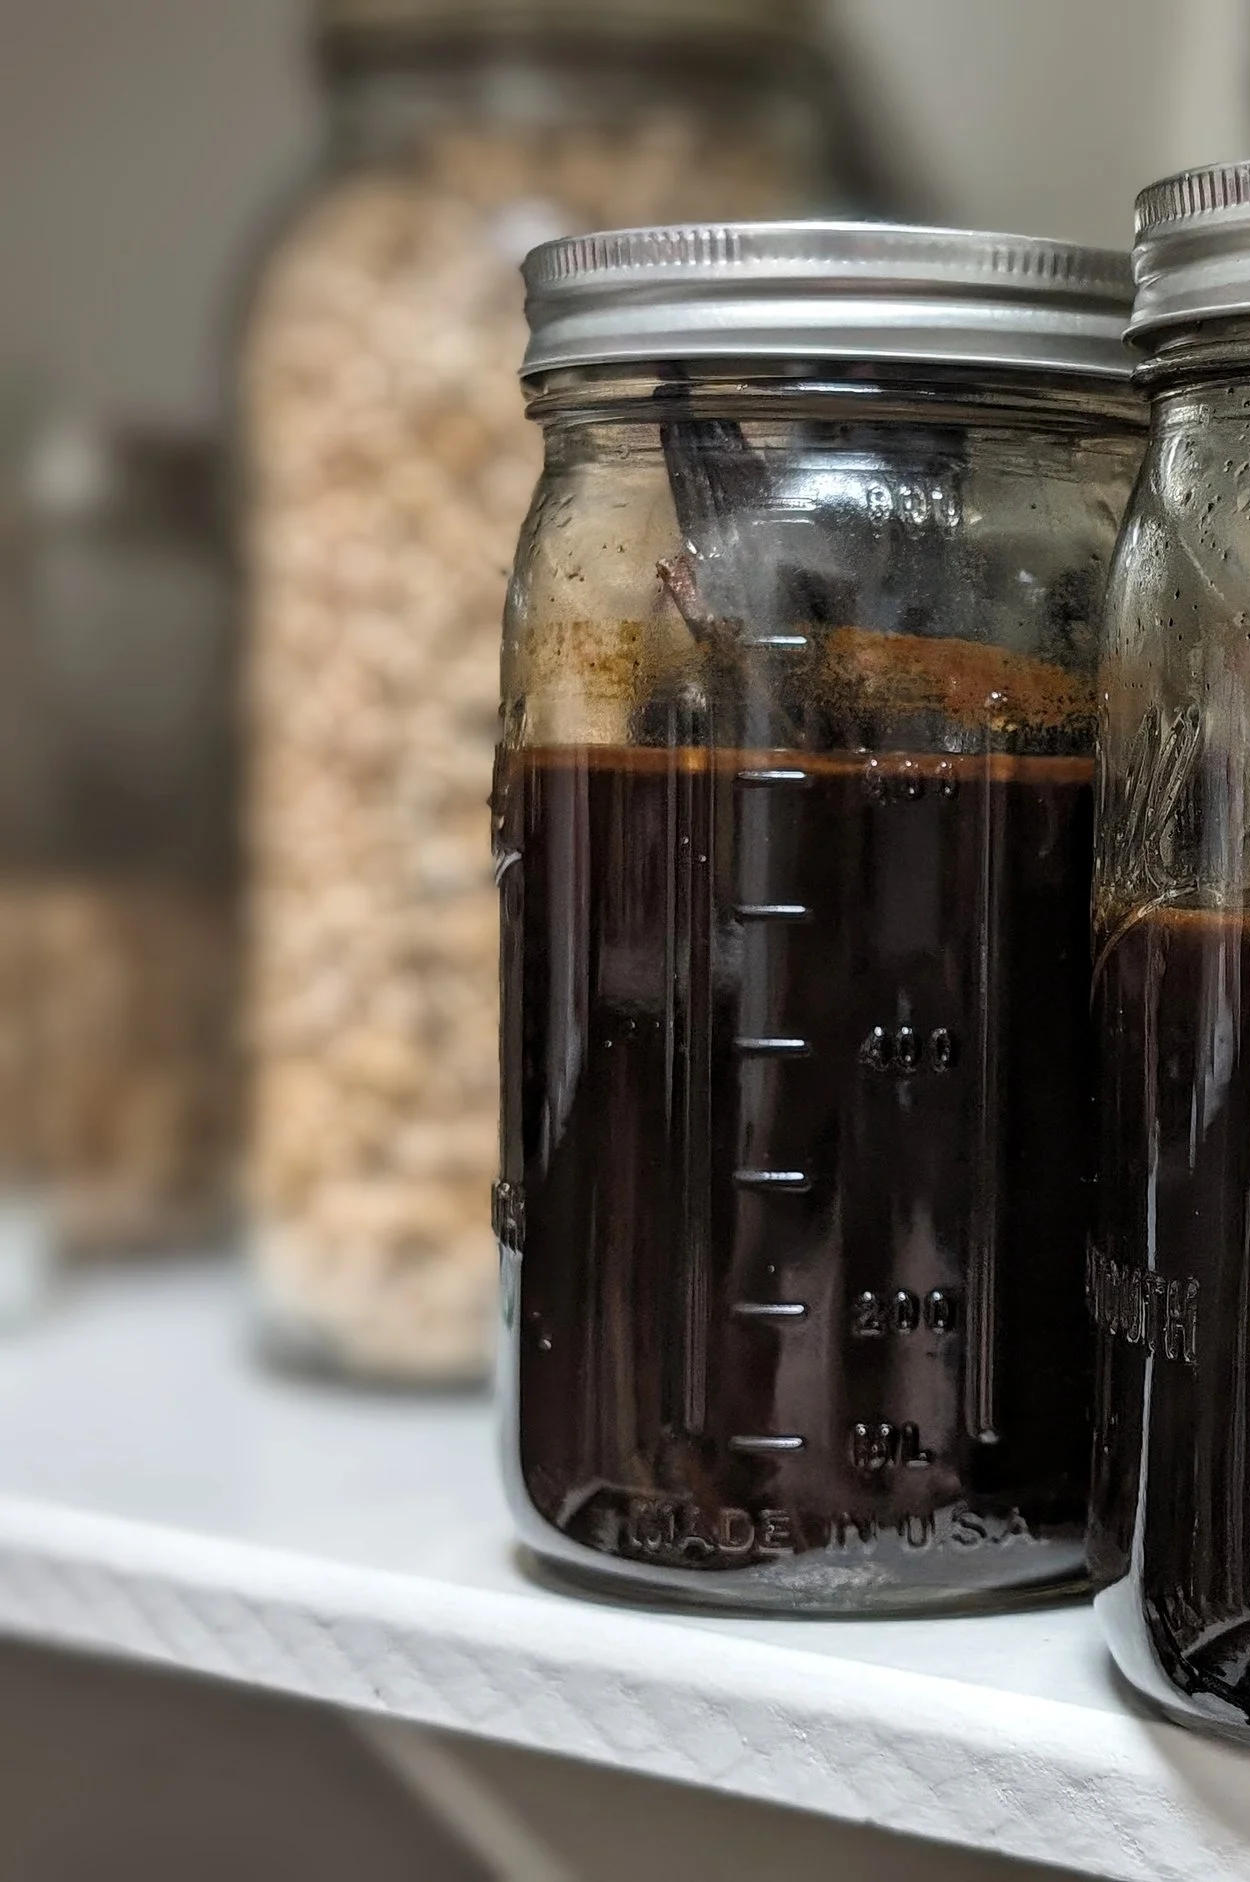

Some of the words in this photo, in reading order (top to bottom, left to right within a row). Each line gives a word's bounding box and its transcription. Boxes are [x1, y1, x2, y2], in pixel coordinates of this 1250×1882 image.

[858, 1025, 957, 1073] 400
[854, 1290, 957, 1336] 200
[853, 1421, 931, 1470] ML
[628, 1500, 798, 1555] MADE
[824, 1508, 882, 1555] IN
